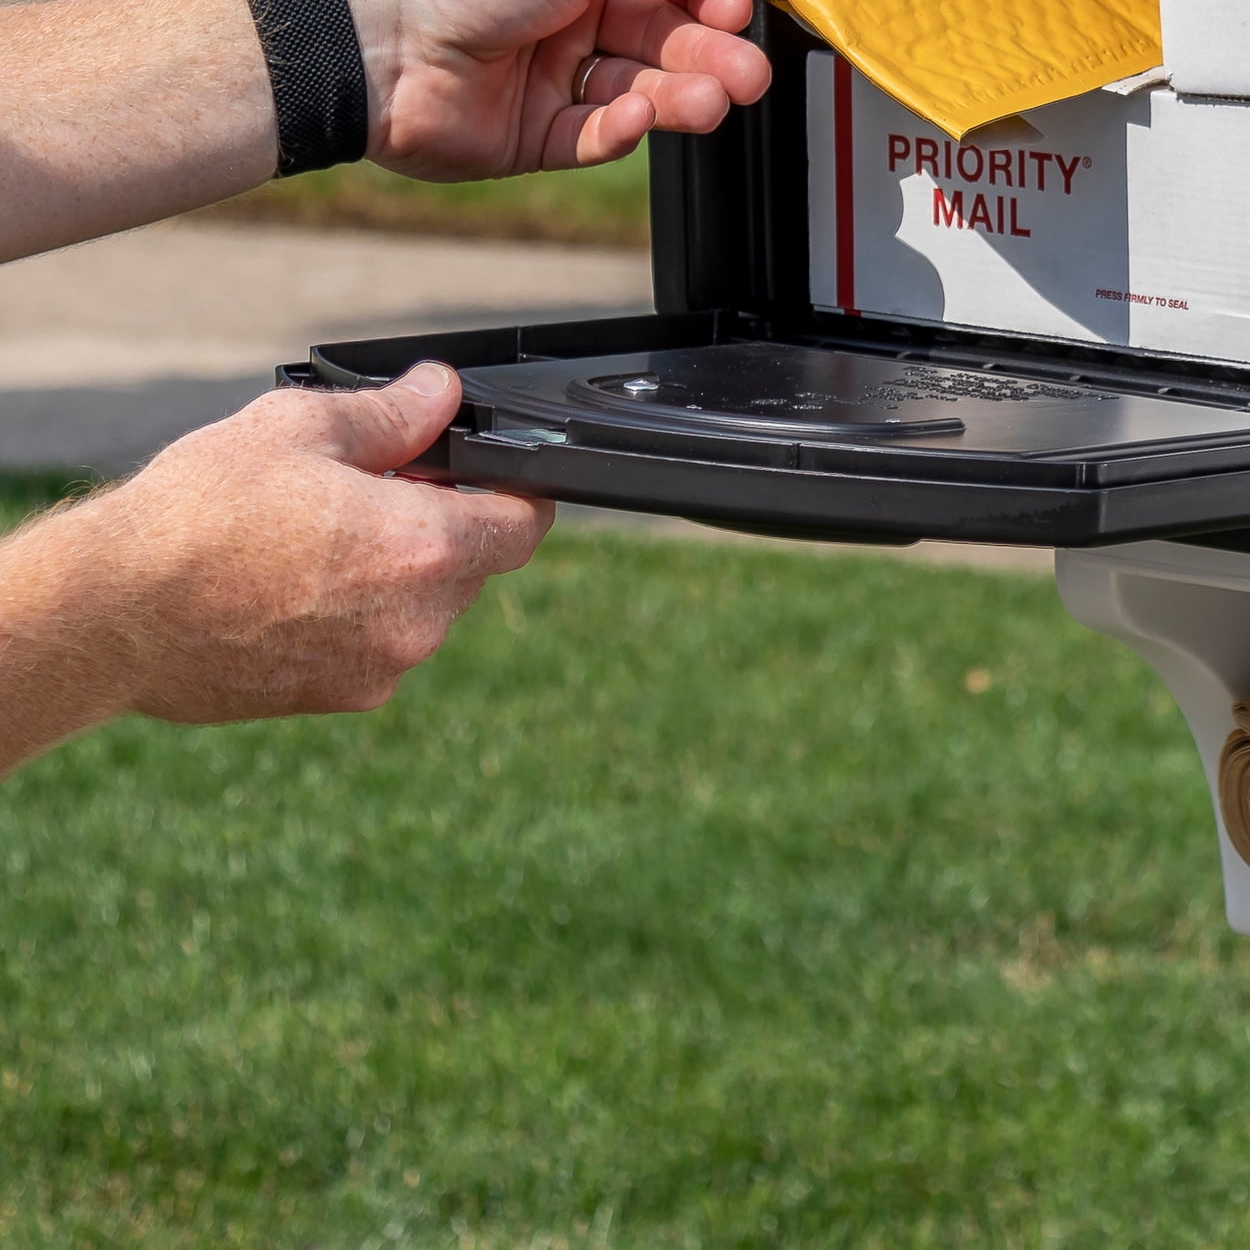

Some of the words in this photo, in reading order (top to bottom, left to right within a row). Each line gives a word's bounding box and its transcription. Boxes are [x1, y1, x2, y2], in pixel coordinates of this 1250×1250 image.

[932, 187, 1032, 238] MAIL
[1095, 288, 1123, 302] PRESS
[1123, 292, 1154, 305] FIRMLY
[1155, 297, 1167, 307] TO
[1167, 299, 1190, 310] SEAL
